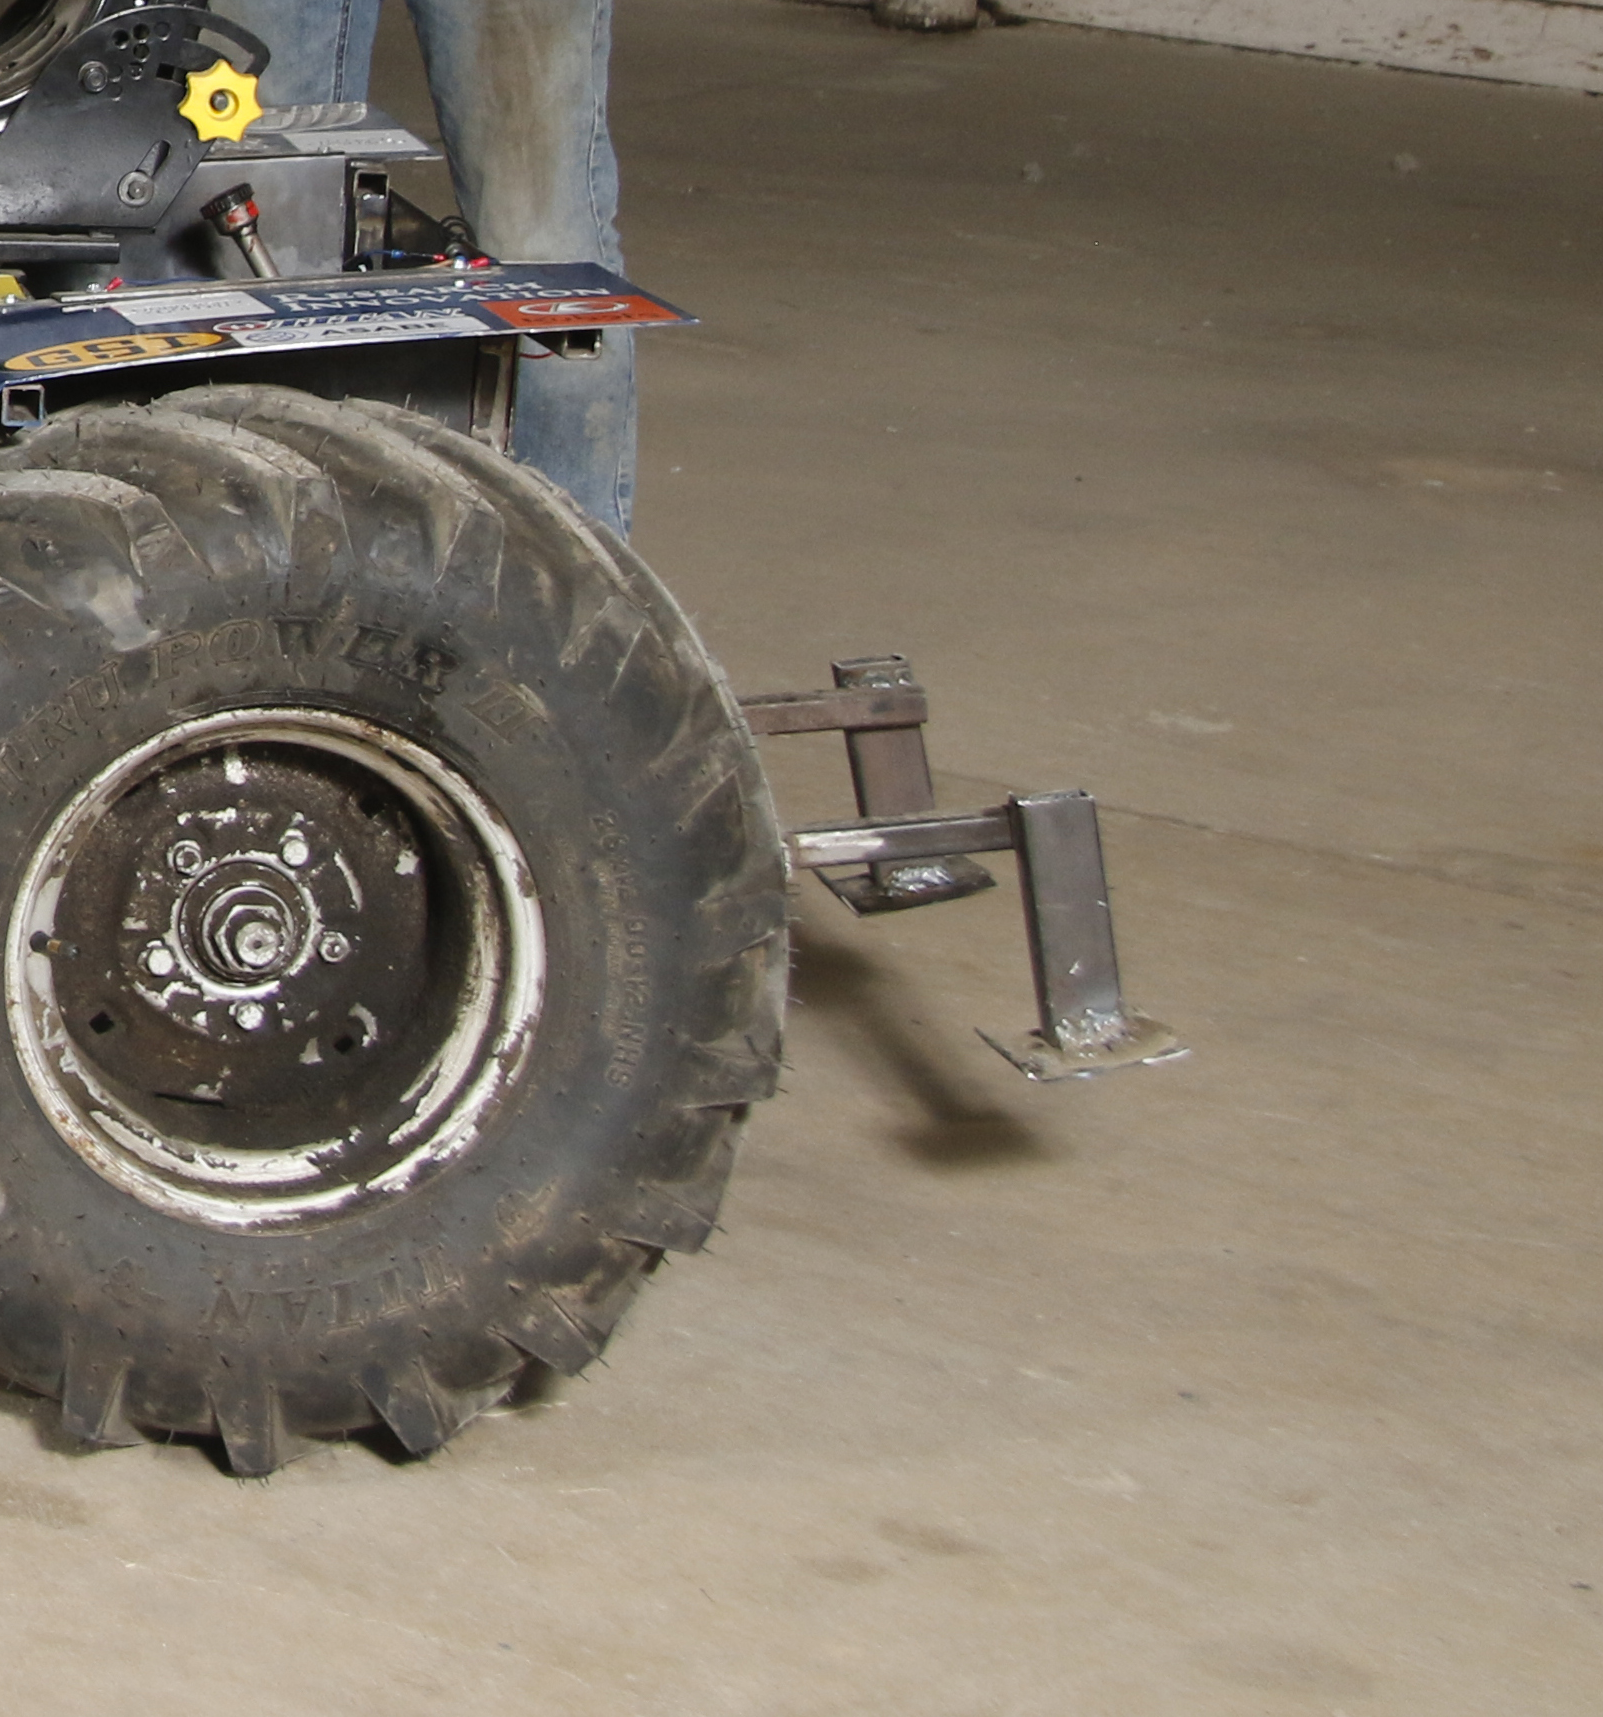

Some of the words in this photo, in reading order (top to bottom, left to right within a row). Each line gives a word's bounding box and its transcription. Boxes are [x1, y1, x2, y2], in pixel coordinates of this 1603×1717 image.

[271, 281, 543, 304] RESEARCH
[282, 287, 611, 312] INNOVATION
[322, 321, 450, 336] ASABE
[26, 333, 198, 367] GSI
